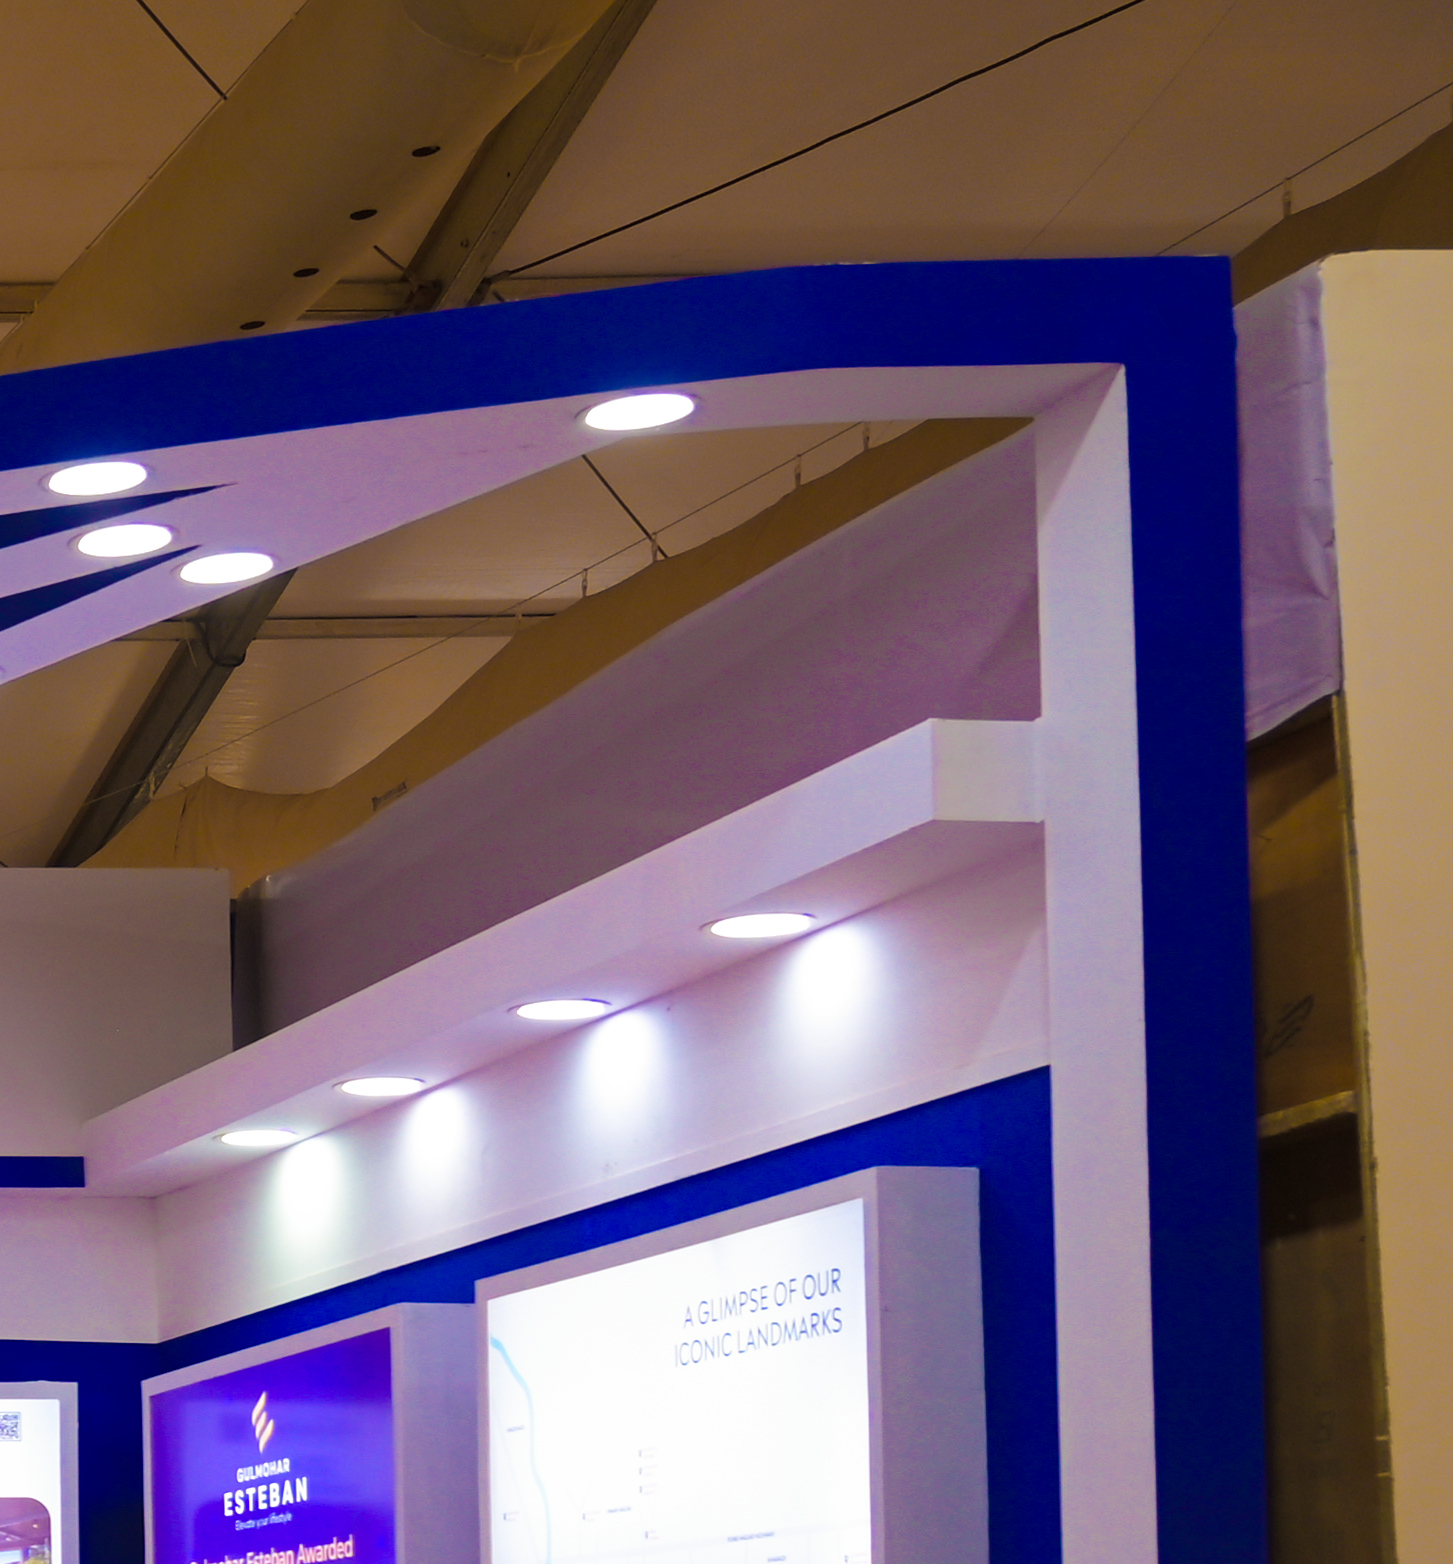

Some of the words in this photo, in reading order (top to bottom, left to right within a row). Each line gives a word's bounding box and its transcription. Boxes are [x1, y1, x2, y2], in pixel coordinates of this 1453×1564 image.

[685, 1307, 693, 1326] A
[699, 1285, 768, 1324] GLIMPSE
[775, 1278, 797, 1306] OF
[803, 1268, 841, 1300] OUR
[676, 1332, 732, 1366] ICONIC
[738, 1305, 842, 1353] LANDMARKS
[236, 1458, 290, 1483] GULMOHAR
[224, 1477, 308, 1517] ESTEBAN
